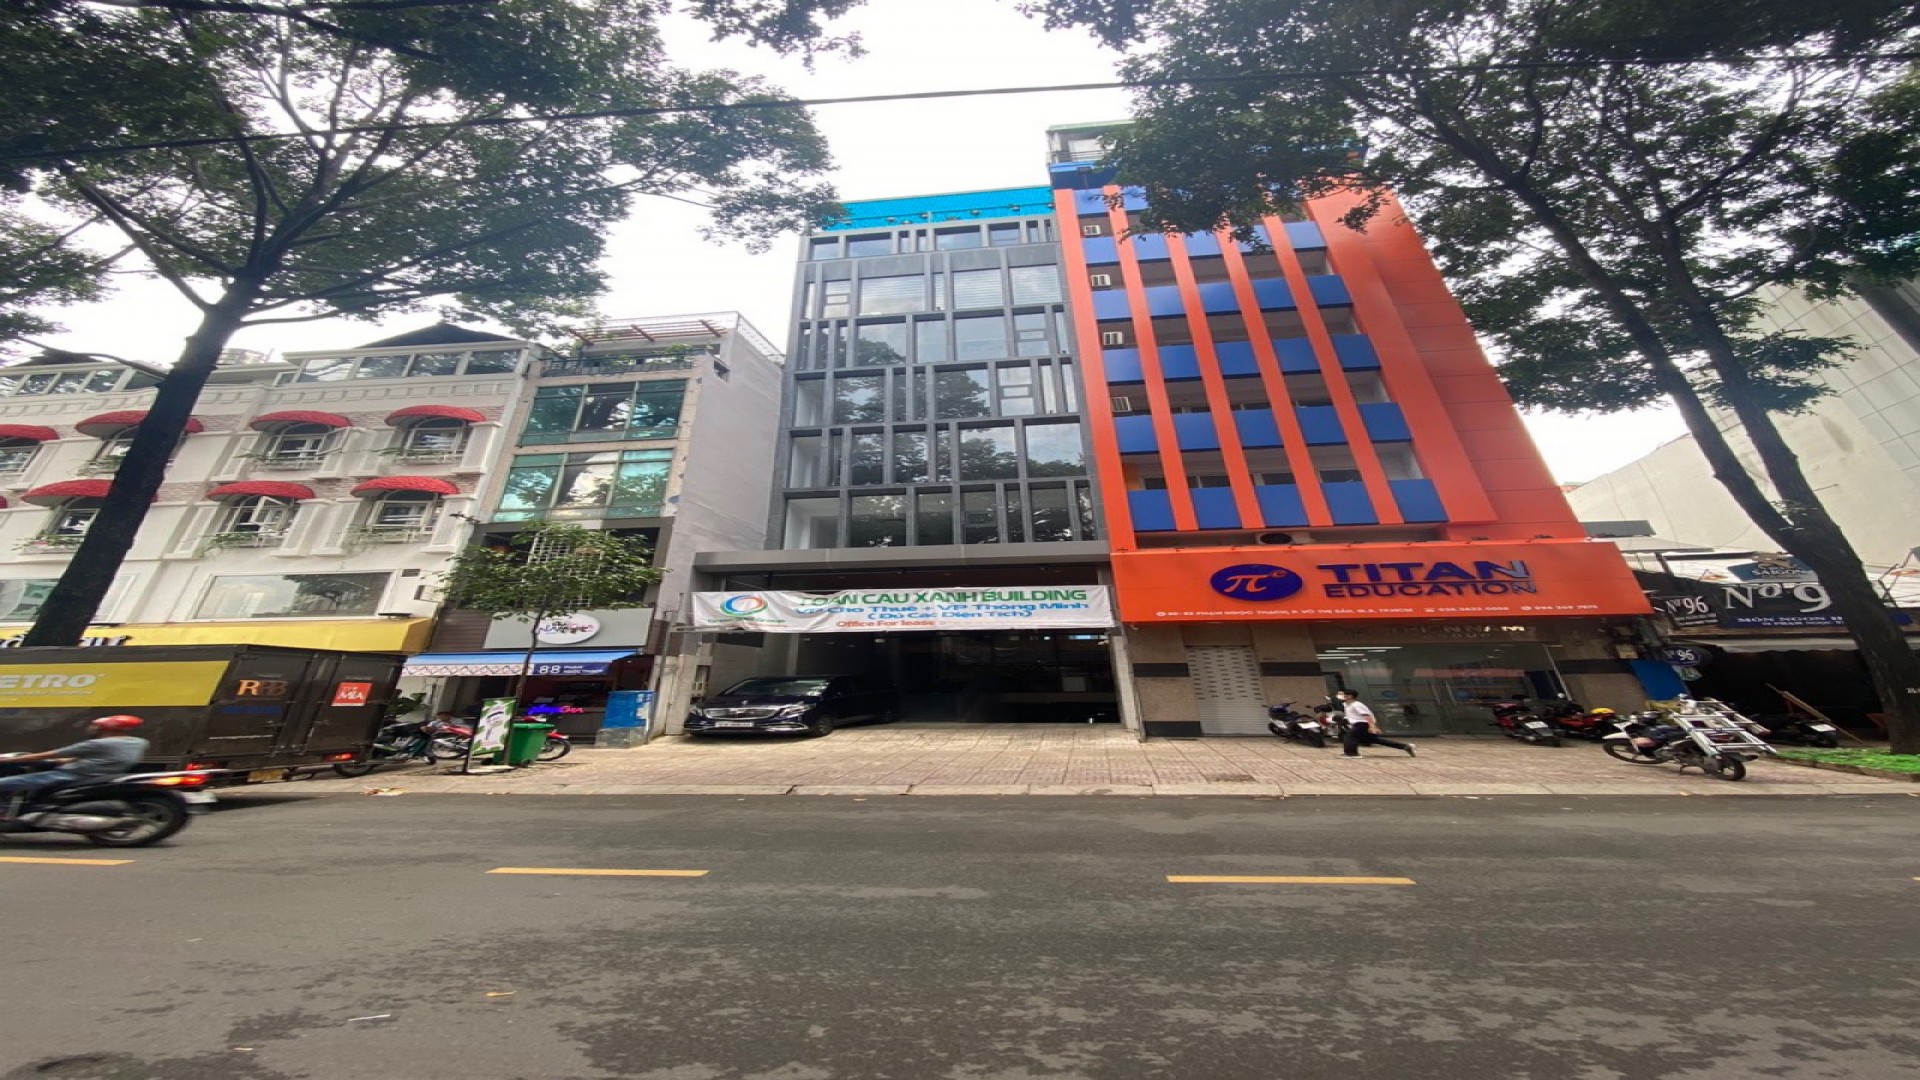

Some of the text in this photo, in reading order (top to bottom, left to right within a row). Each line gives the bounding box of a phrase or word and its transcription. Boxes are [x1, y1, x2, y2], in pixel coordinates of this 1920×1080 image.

[1317, 560, 1530, 582] TITAN
[916, 591, 977, 603] XANH
[981, 589, 1087, 602] BUILDING
[1325, 583, 1537, 598] EDUCATION
[1039, 602, 1090, 610] Minh
[1683, 595, 1709, 614] 96
[539, 664, 561, 674] 88
